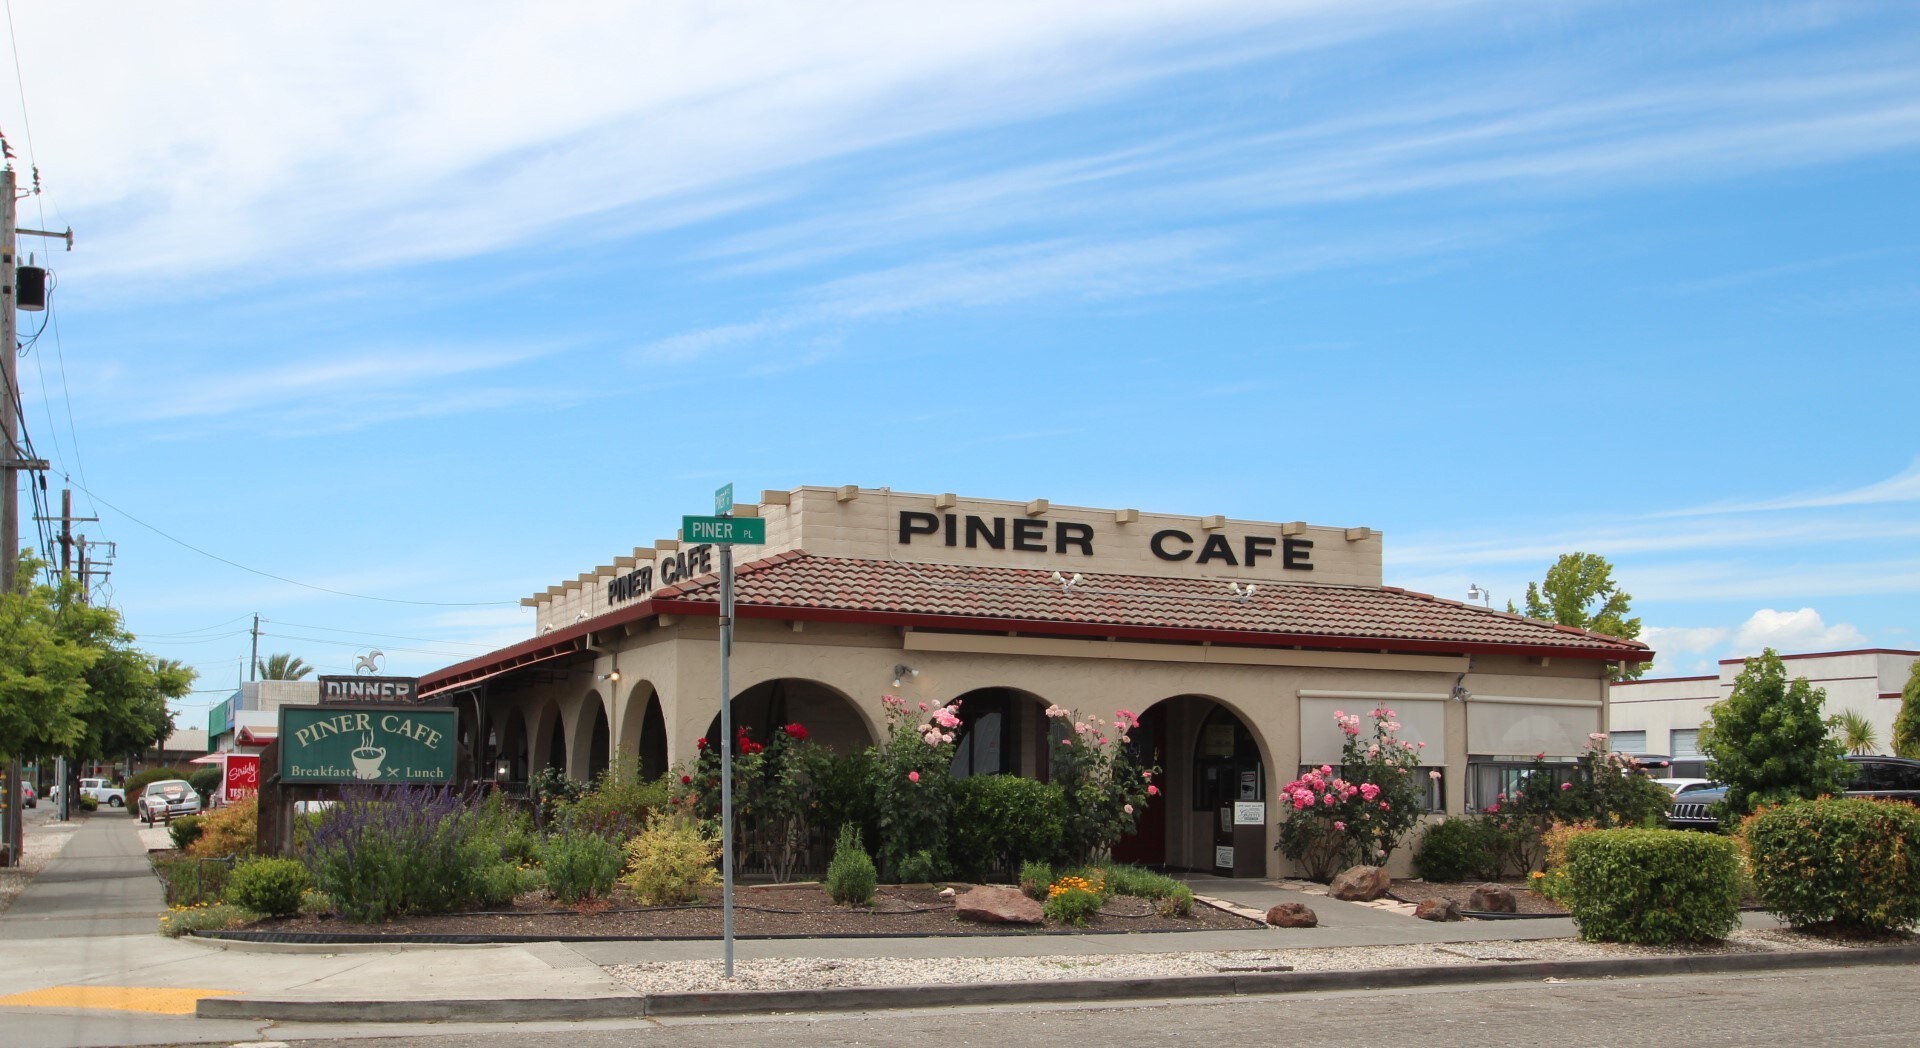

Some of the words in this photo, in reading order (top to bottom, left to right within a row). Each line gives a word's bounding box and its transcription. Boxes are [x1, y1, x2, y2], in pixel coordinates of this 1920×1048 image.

[692, 521, 733, 539] PINER
[743, 529, 753, 539] PL
[898, 511, 1095, 556] PINER
[1150, 529, 1314, 570] CAFE
[608, 565, 653, 606] PINER
[660, 543, 712, 585] CAFE
[326, 681, 412, 703] DINNER
[294, 713, 372, 748] PINER
[381, 715, 442, 749] CAFE
[291, 765, 350, 777] Breakfast
[406, 767, 444, 778] Lunch
